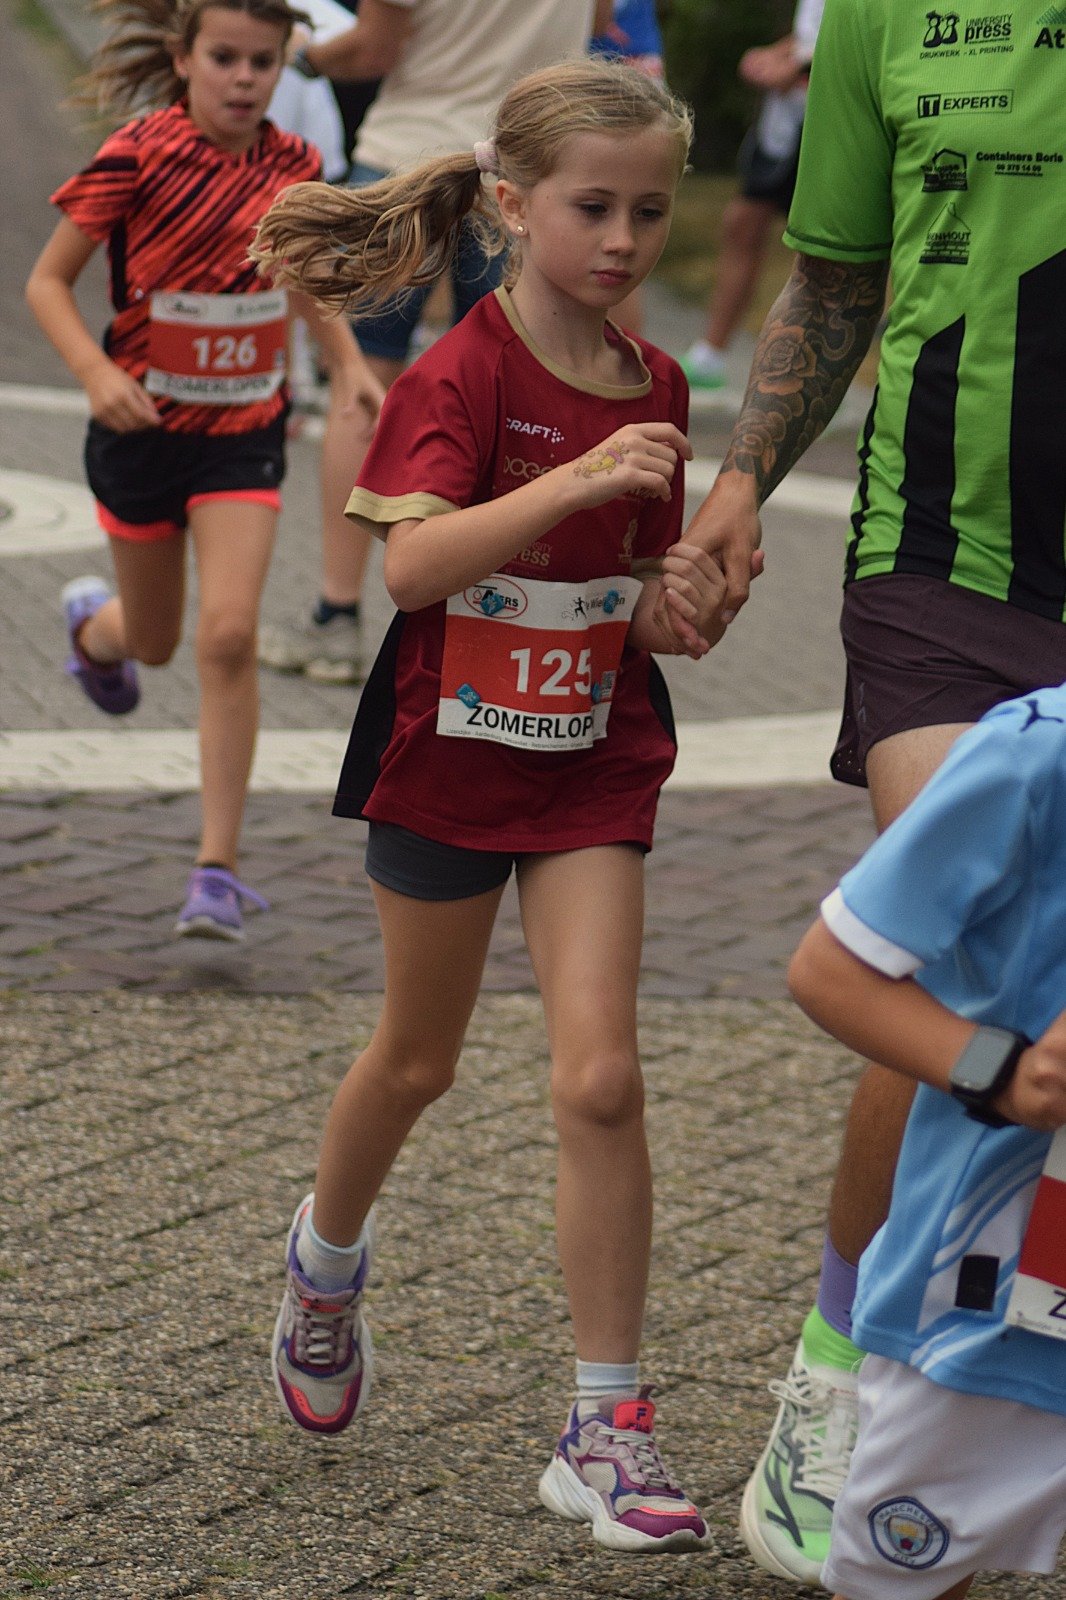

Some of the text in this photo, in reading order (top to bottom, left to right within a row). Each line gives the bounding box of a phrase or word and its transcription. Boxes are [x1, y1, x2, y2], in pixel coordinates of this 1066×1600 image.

[966, 14, 1013, 27] UNIVERSITY
[964, 22, 1012, 44] press
[920, 49, 960, 60] DRUKWERK
[980, 45, 1014, 55] PRINTING
[943, 95, 1008, 110] EXPERTS
[976, 152, 1064, 164] Containers Boris
[192, 334, 257, 370] 126
[510, 648, 591, 696] 125
